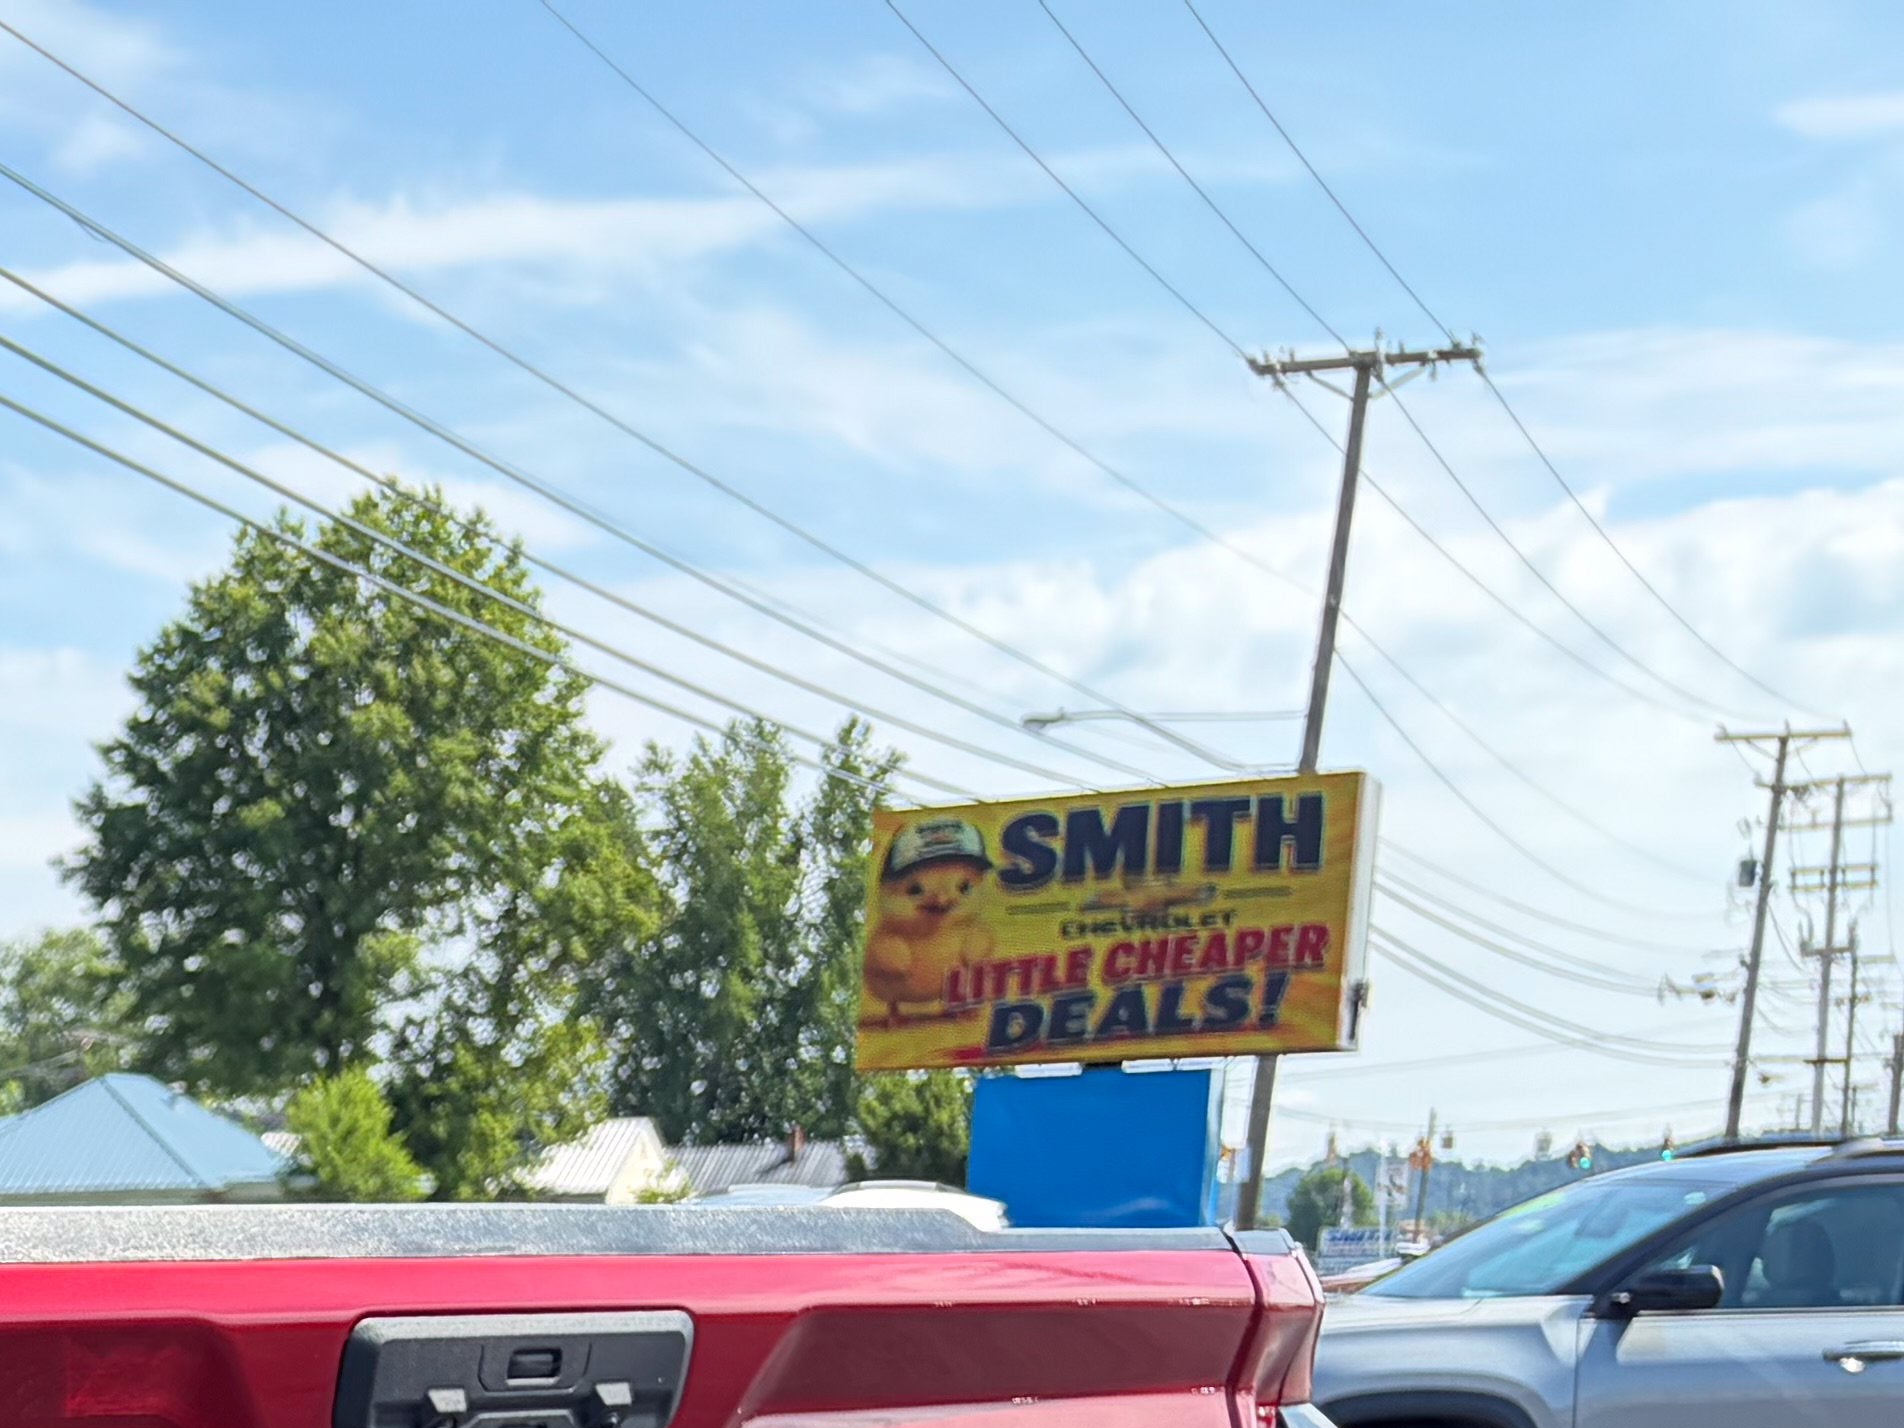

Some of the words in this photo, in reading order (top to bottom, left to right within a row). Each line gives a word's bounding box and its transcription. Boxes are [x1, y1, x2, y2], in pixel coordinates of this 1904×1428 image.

[997, 791, 1324, 891] SMITH
[944, 946, 1094, 1002] LITTLE
[1100, 921, 1331, 982] CHEAPER
[986, 972, 1290, 1051] DEALS!
